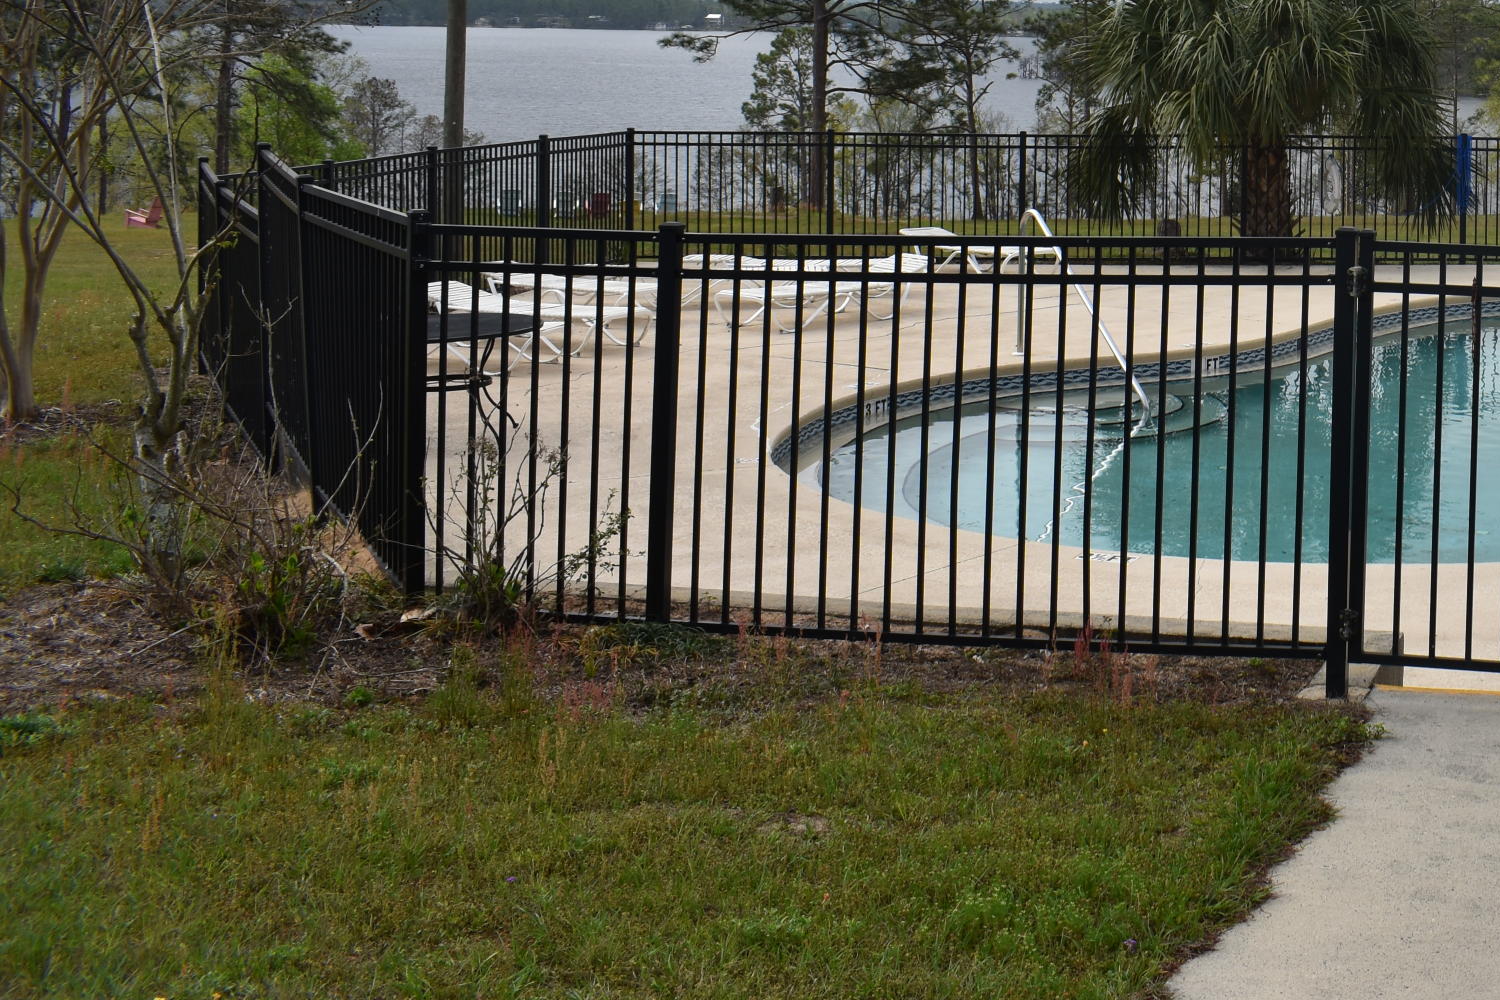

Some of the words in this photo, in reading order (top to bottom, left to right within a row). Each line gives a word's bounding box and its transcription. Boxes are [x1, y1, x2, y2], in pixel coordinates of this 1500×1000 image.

[1206, 357, 1218, 370] FT
[866, 403, 871, 416] 3
[875, 400, 887, 414] FT
